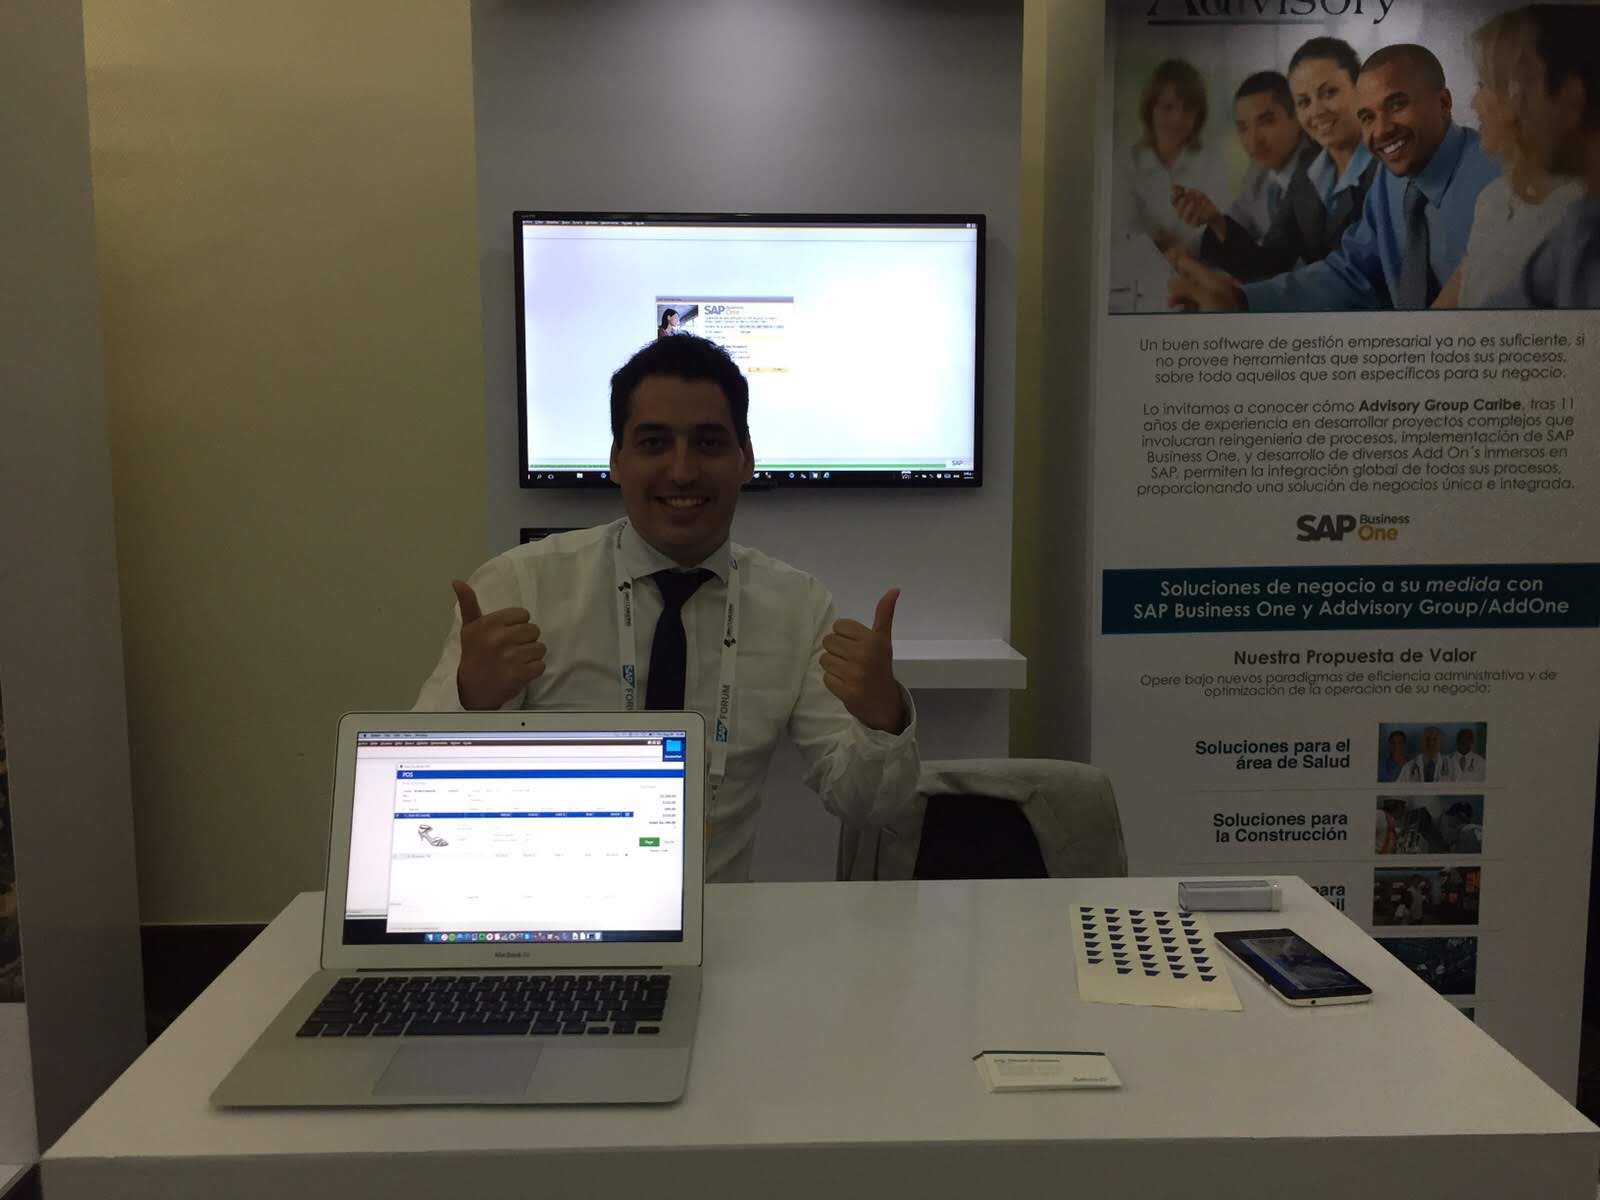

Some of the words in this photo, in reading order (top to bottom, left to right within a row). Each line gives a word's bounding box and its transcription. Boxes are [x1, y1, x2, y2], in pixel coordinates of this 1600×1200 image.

[704, 305, 725, 315] SAP
[1140, 339, 1158, 352] Un
[1162, 339, 1199, 351] buen
[1203, 338, 1264, 350] software
[1268, 337, 1287, 349] de
[1292, 335, 1344, 351] gestión
[1348, 336, 1431, 348] empresarial
[1435, 337, 1453, 349] ya
[1458, 336, 1476, 347] no
[1480, 336, 1495, 346] es
[1500, 333, 1572, 347] suficiente,
[1576, 334, 1584, 346] si
[1155, 357, 1174, 367] no
[1178, 355, 1228, 368] provee
[1233, 353, 1326, 366] herramientas
[1330, 353, 1357, 367] que
[1363, 352, 1425, 365] soporten
[1431, 351, 1470, 363] todos
[1475, 352, 1494, 362] sus
[1155, 372, 1194, 383] sobre
[1199, 371, 1231, 382] todo
[1236, 370, 1296, 384] aquellos
[1300, 370, 1327, 384] que
[1332, 370, 1356, 380] son
[1361, 367, 1440, 381] específicos
[1444, 368, 1479, 381] para
[1483, 368, 1497, 378] su
[1144, 403, 1158, 415] Lo
[1163, 402, 1230, 415] invitamos
[1234, 403, 1243, 414] a
[1248, 402, 1307, 413] conocer
[1312, 400, 1354, 412] cómo
[1359, 400, 1419, 413] Advisory
[1425, 400, 1469, 413] Group
[1531, 398, 1555, 410] tras
[1561, 399, 1574, 409] 11
[1144, 419, 1177, 432] años
[1181, 419, 1200, 430] de
[1205, 417, 1287, 432] experiencia
[1292, 419, 1310, 429] en
[1315, 416, 1388, 430] desarrollar
[1392, 416, 1463, 429] proyectos
[1468, 415, 1541, 429] complejos
[1546, 416, 1574, 428] que
[1142, 435, 1215, 447] involucran
[1219, 432, 1302, 448] reingeniería
[1306, 433, 1326, 445] de
[1330, 433, 1396, 447] procesos,
[1401, 432, 1519, 444] implementación
[1524, 431, 1543, 442] de
[1547, 430, 1574, 442] SAP
[1147, 451, 1202, 463] Business
[1206, 450, 1240, 463] One,
[1245, 452, 1253, 463] y
[1256, 449, 1324, 461] desarrollo
[1329, 448, 1349, 460] de
[1353, 448, 1408, 460] diversos
[1412, 448, 1443, 459] Add
[1484, 446, 1544, 458] inmersos
[1549, 448, 1567, 457] en
[1184, 466, 1246, 480] permiten
[1251, 466, 1263, 477] la
[1267, 464, 1349, 479] integración
[1353, 464, 1398, 478] global
[1402, 463, 1422, 475] de
[1426, 463, 1465, 475] todos
[1470, 464, 1489, 474] sus
[1494, 463, 1561, 476] procesos,
[1137, 482, 1251, 496] proporcionando
[1256, 482, 1283, 493] una
[1288, 480, 1345, 493] solución
[1350, 480, 1368, 491] de
[1373, 478, 1439, 494] negocios
[1443, 477, 1482, 490] única
[1487, 480, 1495, 490] e
[1500, 478, 1575, 493] integrada.
[1296, 514, 1356, 541] SAP
[1360, 512, 1410, 524] Business
[1358, 525, 1398, 540] One
[1160, 580, 1261, 596] Soluciones
[1266, 579, 1292, 595] de
[1296, 579, 1377, 599] negocio
[1382, 581, 1394, 593] a
[1400, 581, 1420, 593] su
[1425, 577, 1500, 593] medida
[1506, 579, 1543, 592] con
[1133, 604, 1168, 619] SAP
[1174, 602, 1250, 619] Business
[1256, 602, 1296, 617] One
[1303, 604, 1312, 620] y
[1319, 600, 1412, 620] Addvisory
[1419, 598, 1569, 618] Group/AddOne
[1233, 650, 1300, 666] Nuestra
[1306, 648, 1394, 667] Propuesta
[1400, 648, 1423, 663] de
[1429, 647, 1476, 663] Valor
[623, 665, 635, 684] SAP
[1140, 674, 1181, 687] Opere
[1185, 674, 1214, 687] bajo
[1217, 673, 1262, 684] nuevos
[1266, 672, 1343, 686] paradigmas
[1346, 672, 1364, 681] de
[1368, 671, 1431, 682] eficiencia
[1435, 670, 1524, 680] administrativa
[1528, 671, 1535, 682] y
[1539, 670, 1556, 680] de
[1205, 684, 1285, 698] optimización
[1288, 685, 1305, 695] de
[1310, 685, 1321, 694] la
[1395, 683, 1412, 693] de
[1416, 684, 1429, 693] su
[718, 684, 731, 720] FORUM
[716, 724, 727, 743] SAP
[1195, 739, 1289, 755] Soluciones
[1293, 740, 1331, 757] para
[1335, 739, 1351, 753] el
[1236, 753, 1272, 770] área
[1276, 754, 1298, 769] de
[1303, 752, 1351, 769] Salud
[1213, 811, 1305, 828] Soluciones
[1311, 814, 1348, 829] para
[1215, 828, 1230, 843] la
[1235, 825, 1347, 843] Construcción
